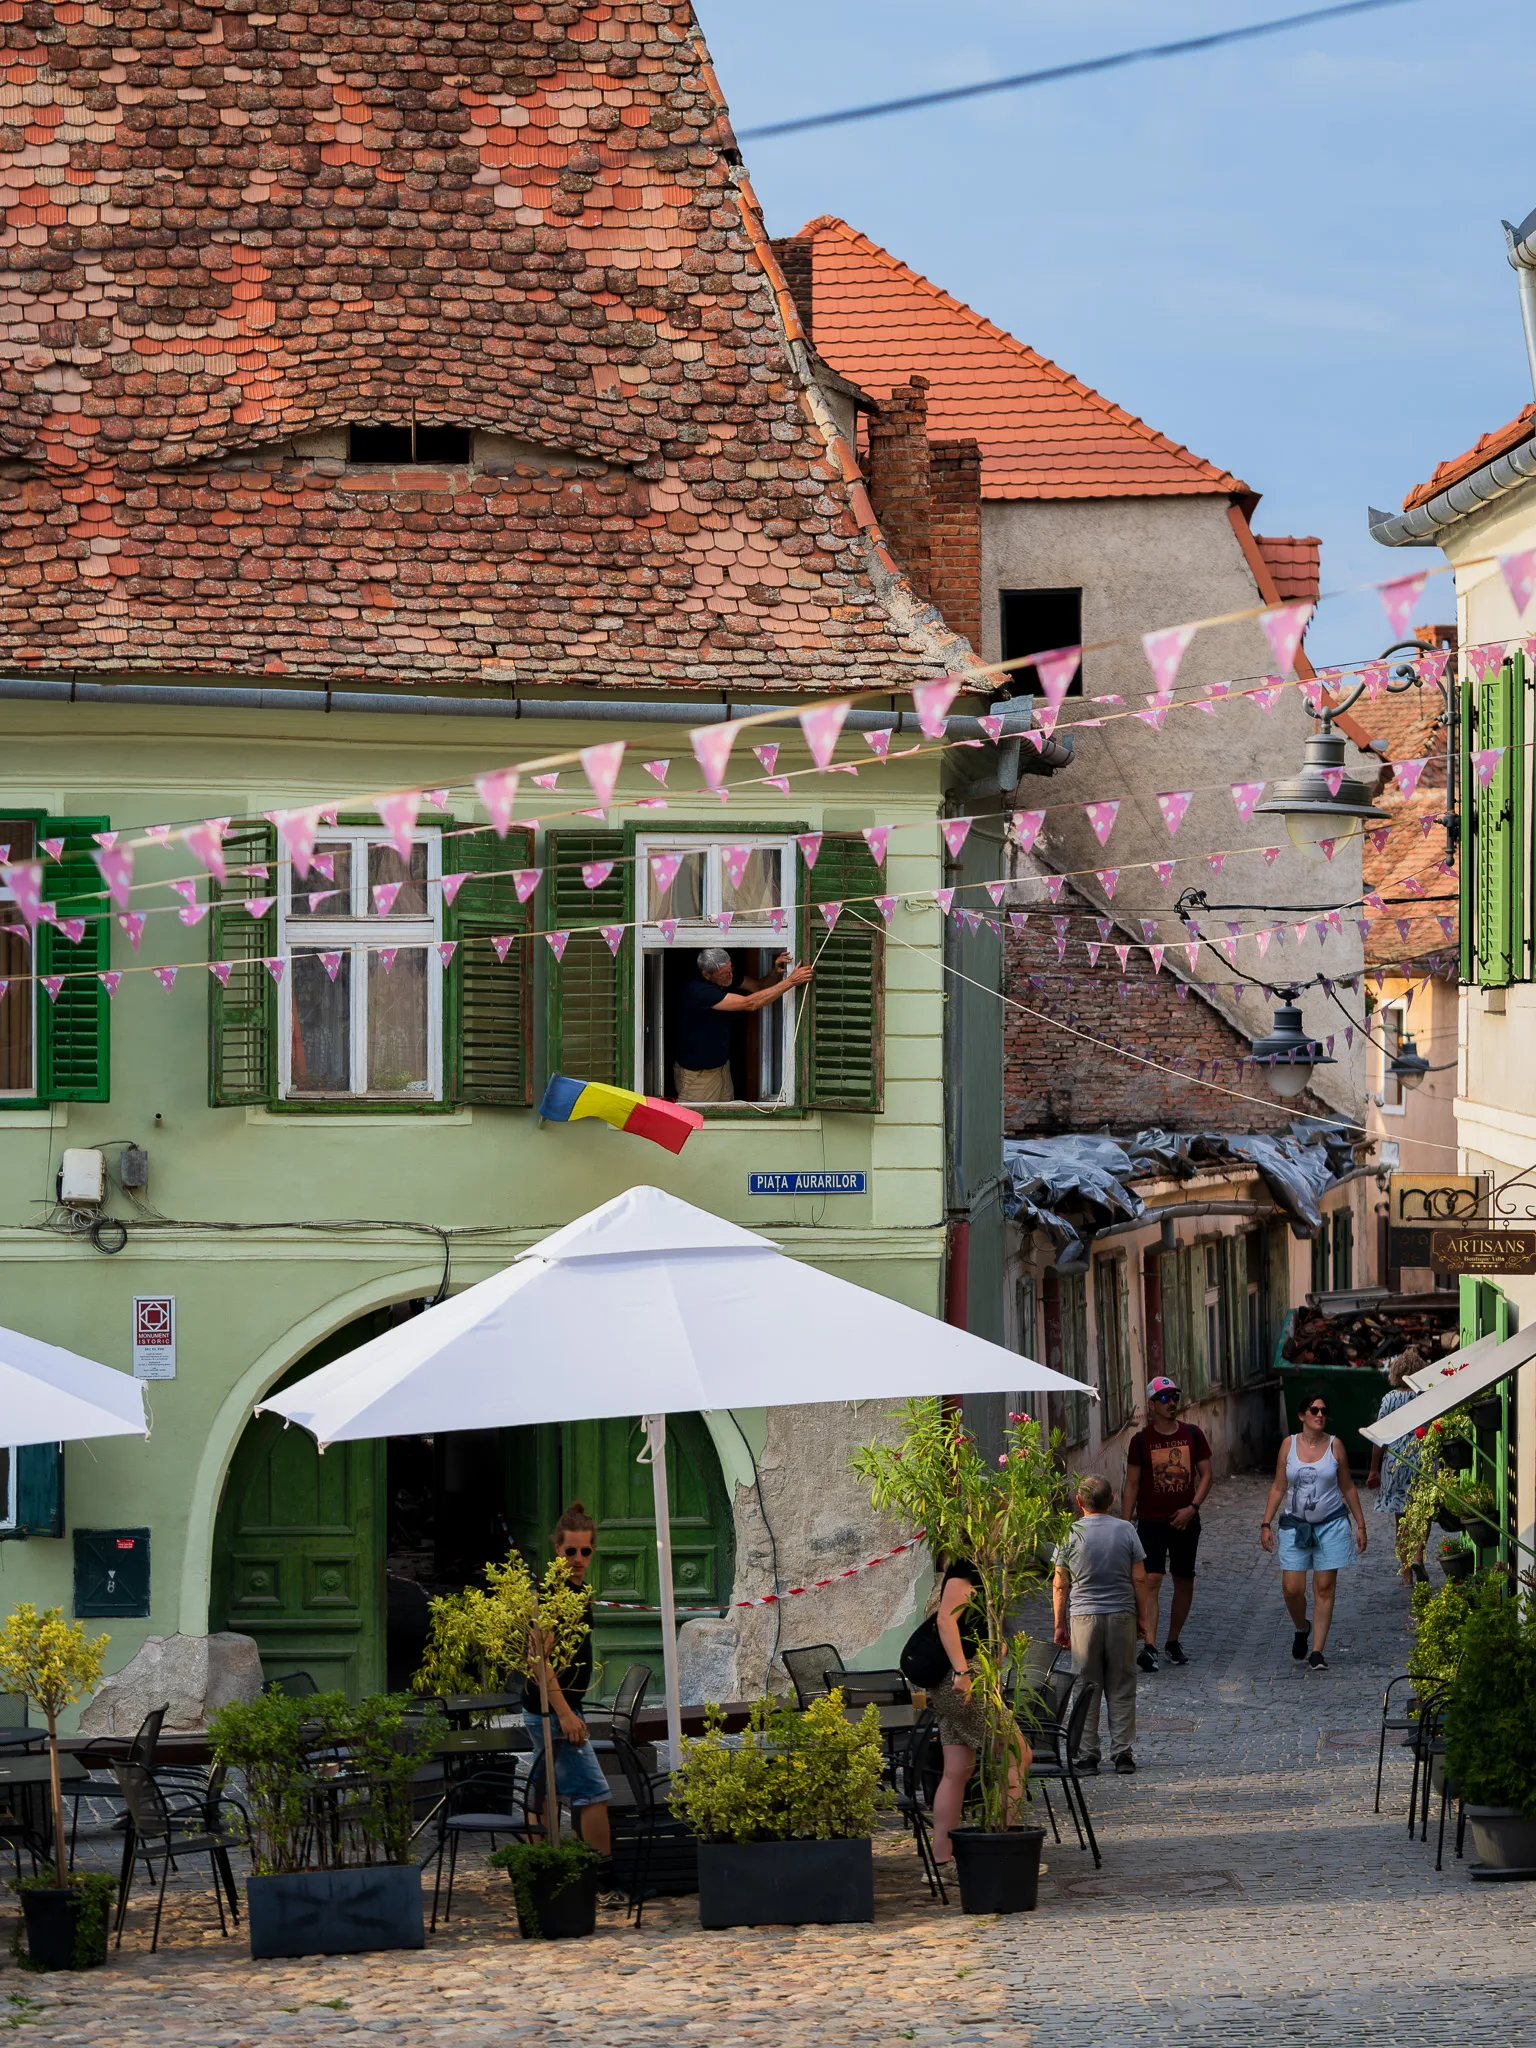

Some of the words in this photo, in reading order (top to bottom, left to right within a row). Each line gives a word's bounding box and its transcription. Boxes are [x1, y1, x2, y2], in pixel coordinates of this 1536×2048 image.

[795, 1175, 857, 1188] AURARILOR
[1446, 1239, 1525, 1253] ARTISANS
[1165, 1440, 1188, 1448] TONY
[1154, 1484, 1189, 1493] STARK
